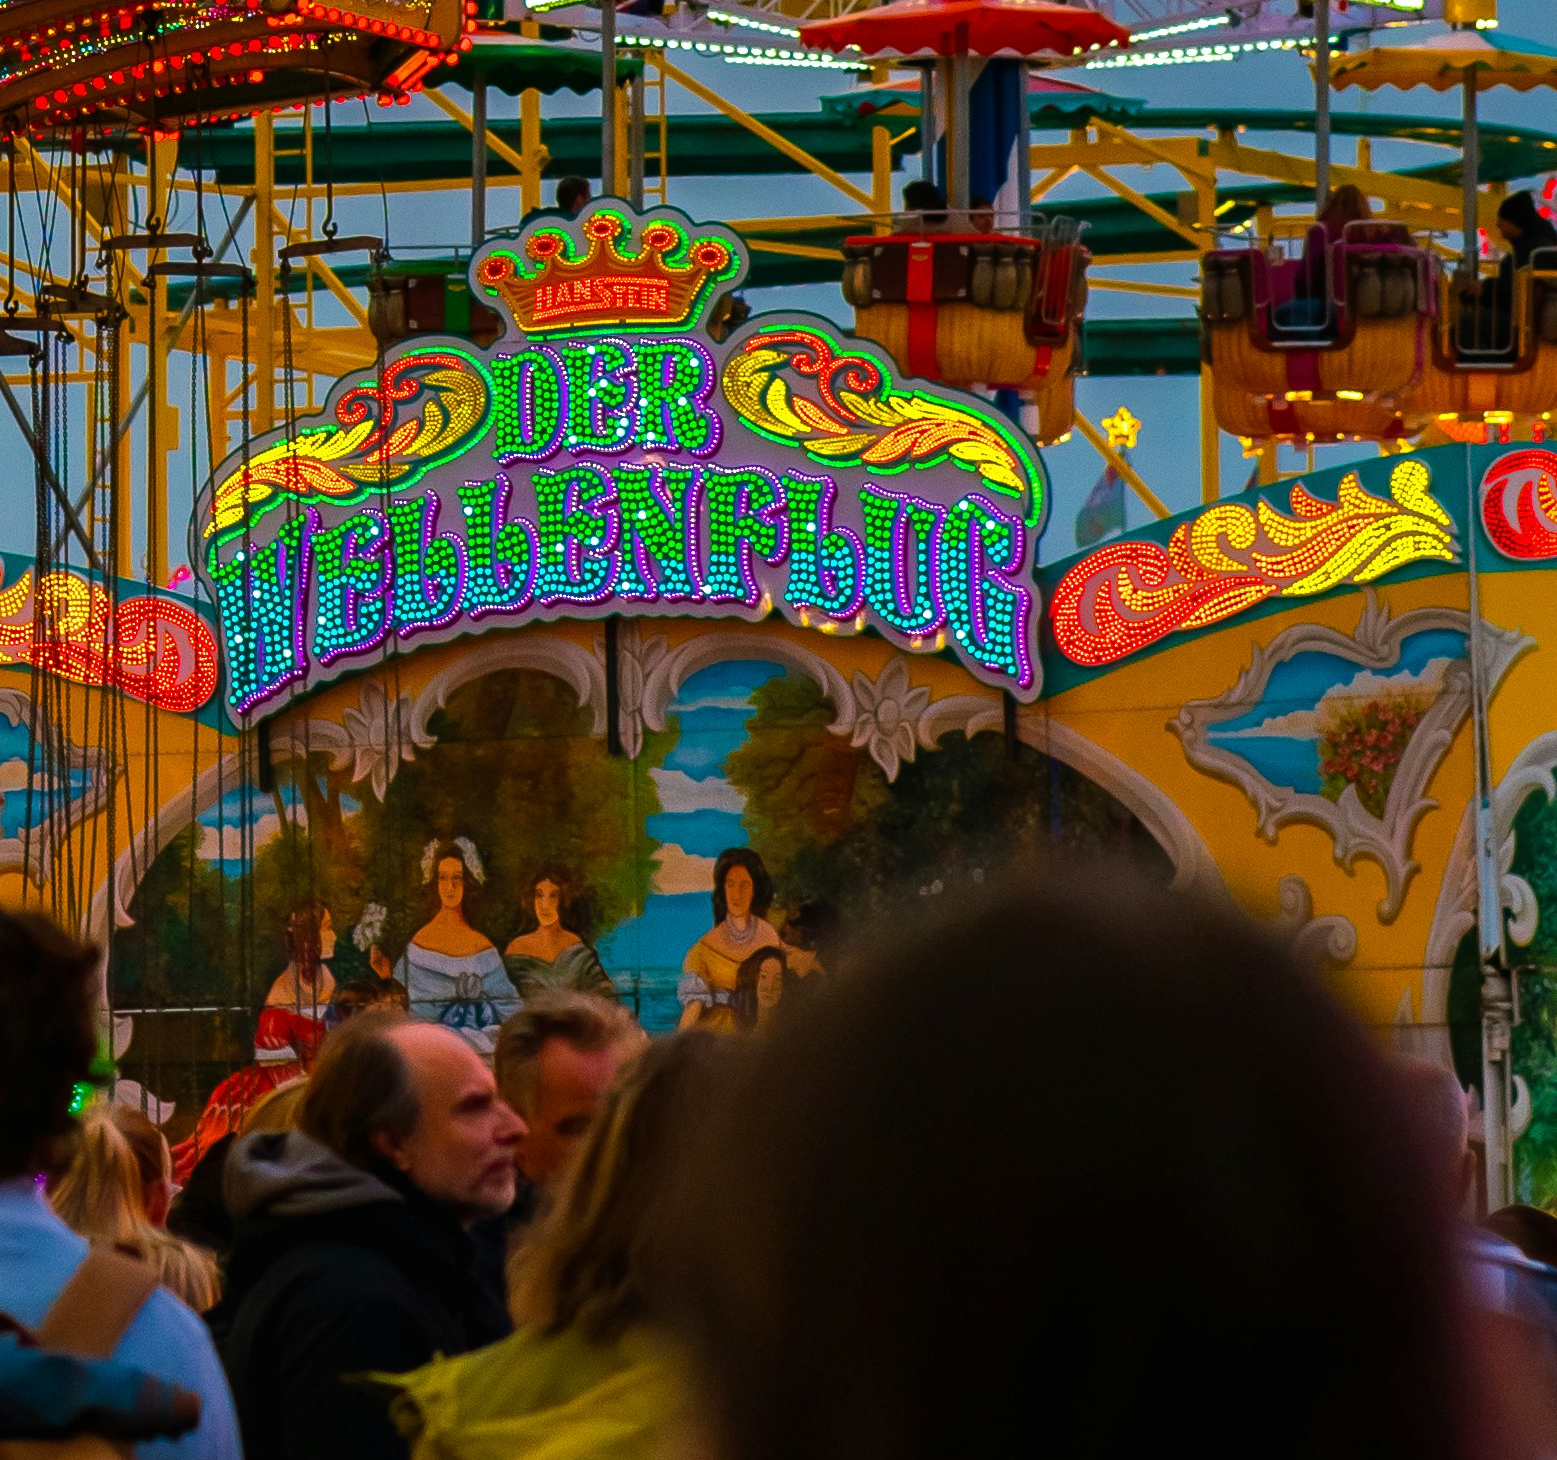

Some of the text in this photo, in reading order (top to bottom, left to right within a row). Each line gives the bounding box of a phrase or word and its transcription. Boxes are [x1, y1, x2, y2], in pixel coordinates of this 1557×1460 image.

[533, 276, 671, 322] HANSTEIN
[490, 335, 727, 466] DER
[211, 461, 1037, 717] WELLENFLUG
